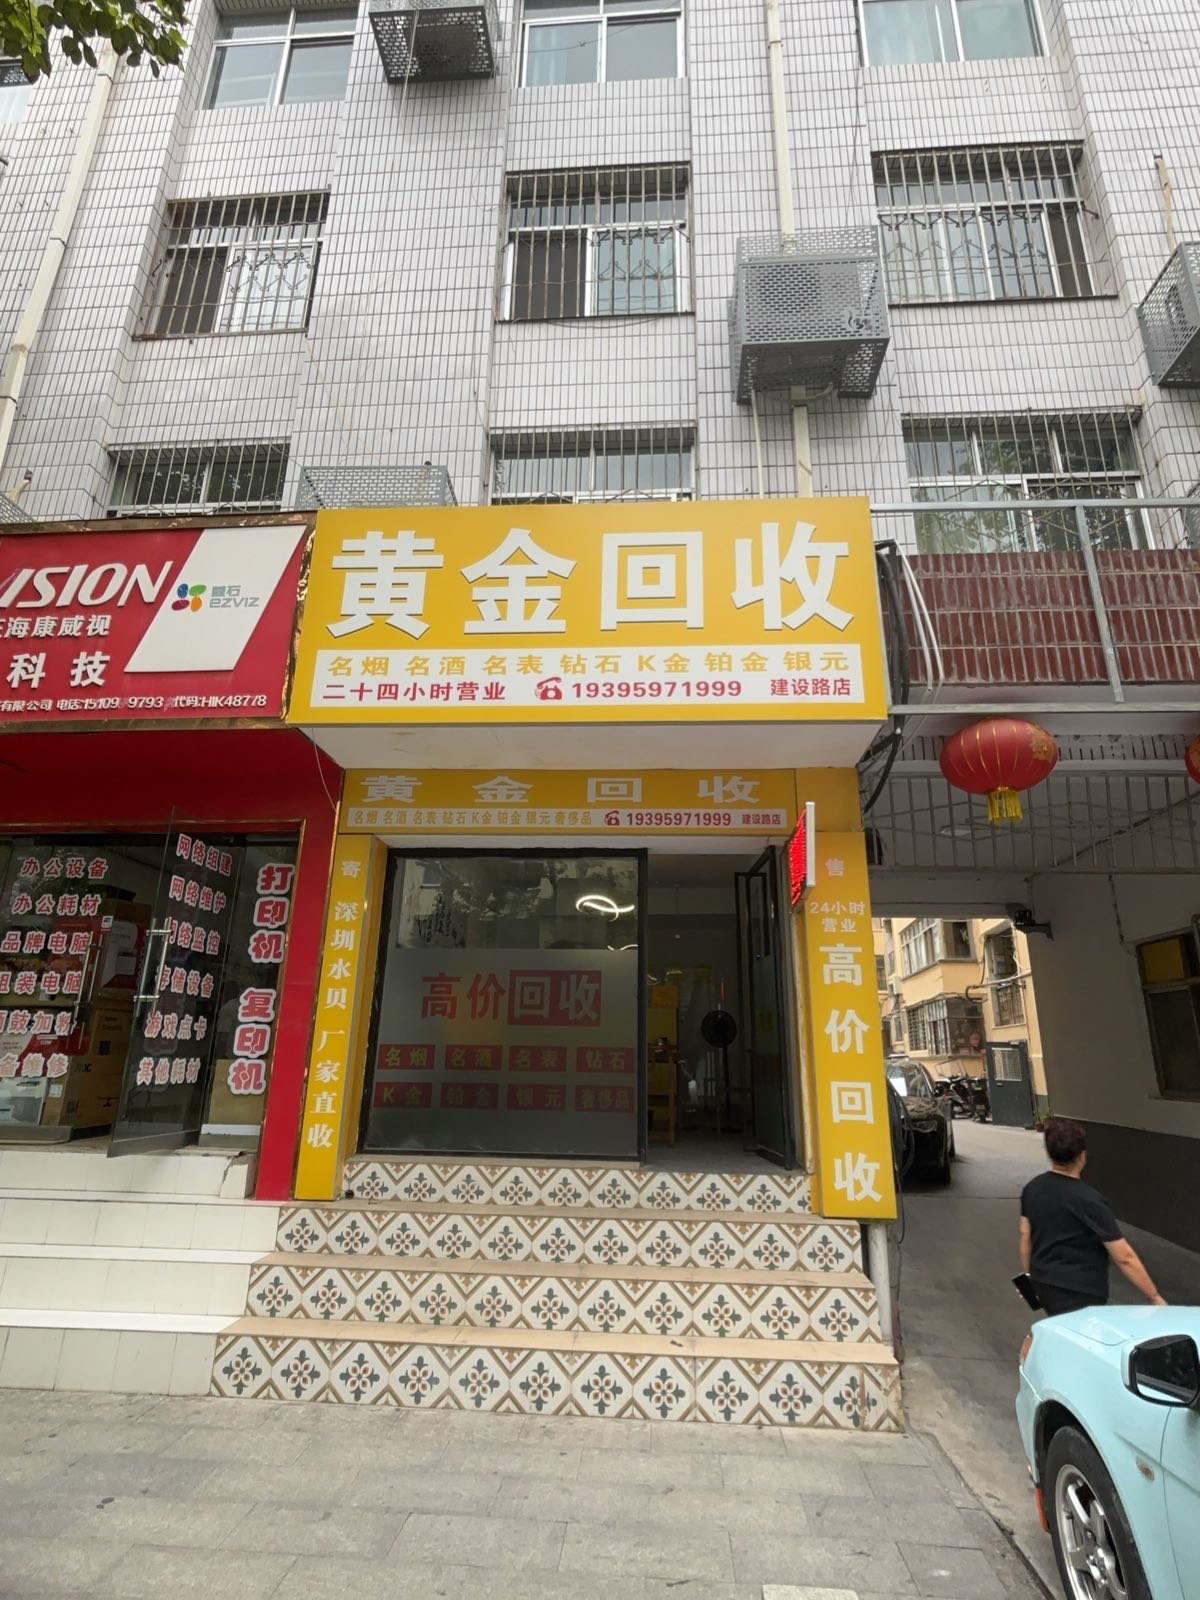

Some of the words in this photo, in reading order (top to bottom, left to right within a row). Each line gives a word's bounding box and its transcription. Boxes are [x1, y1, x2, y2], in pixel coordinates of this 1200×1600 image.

[327, 521, 855, 640] 黄金回收
[328, 656, 389, 676] 名烟
[405, 656, 465, 676] 名酒
[482, 655, 544, 676] 名表
[560, 654, 621, 675] 钻石
[638, 653, 690, 673] K金
[705, 652, 768, 672] 铂金
[783, 651, 849, 671] 银元
[127, 696, 164, 709] 9793
[322, 682, 506, 702] 二十四小时营业
[572, 681, 742, 698] 19395971999
[770, 678, 851, 696] 建设路店
[360, 775, 760, 803] 黄金回收
[626, 812, 731, 826] 19395971999
[742, 814, 781, 825] 建设路店
[176, 833, 232, 877] 网络组建
[20, 857, 108, 879] 办公设备
[341, 860, 361, 878] 寄
[12, 893, 101, 916] 办公耗材
[169, 875, 226, 914] 网络维护
[0, 931, 90, 954] 品牌电脑
[421, 972, 599, 1021] 高价回收
[0, 1009, 76, 1036] 鼓加粉
[819, 942, 882, 1202] 高价回收
